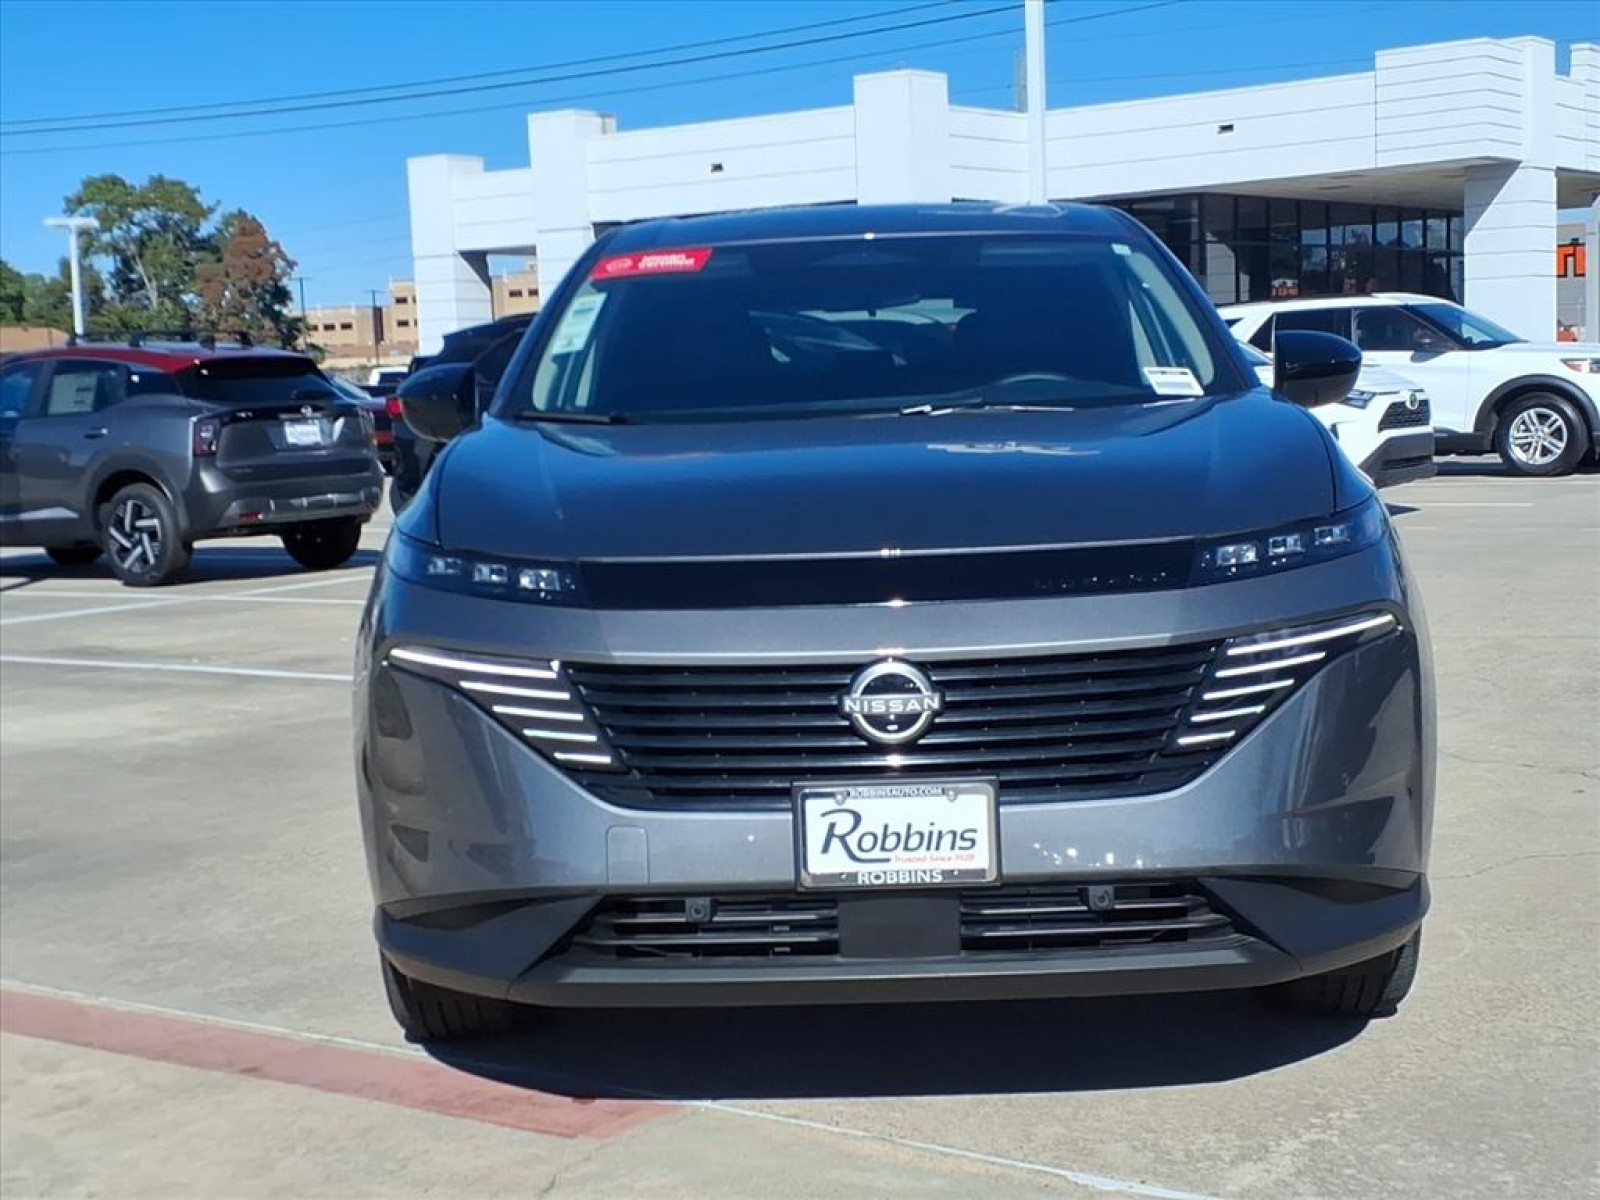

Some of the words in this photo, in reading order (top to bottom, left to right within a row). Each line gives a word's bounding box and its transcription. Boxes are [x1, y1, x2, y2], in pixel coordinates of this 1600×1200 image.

[842, 693, 941, 713] NISSAN
[820, 808, 978, 863] Robbins
[857, 869, 943, 885] ROBBINS
